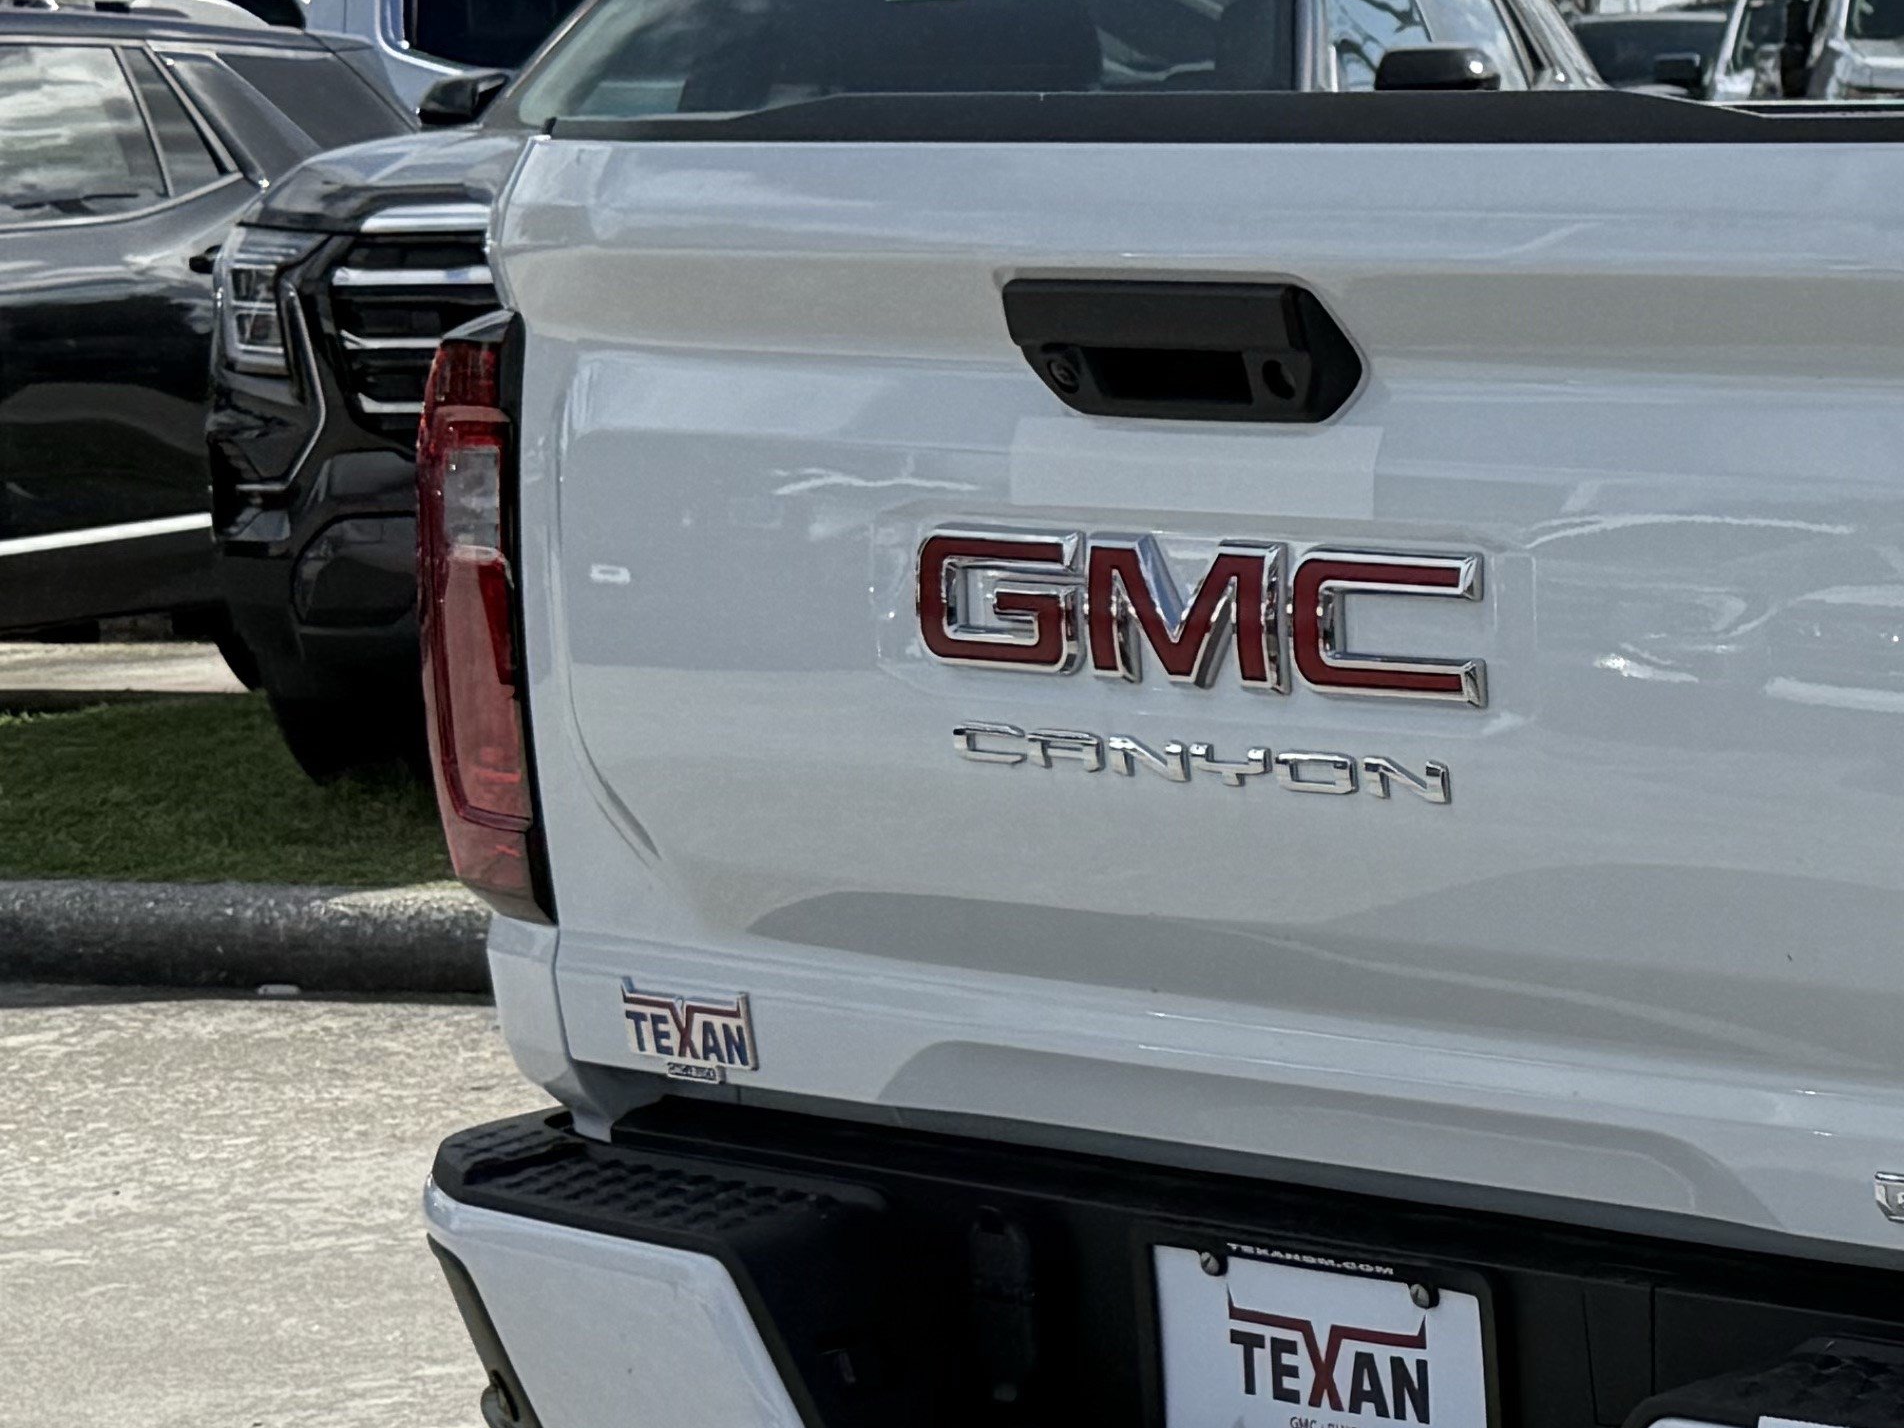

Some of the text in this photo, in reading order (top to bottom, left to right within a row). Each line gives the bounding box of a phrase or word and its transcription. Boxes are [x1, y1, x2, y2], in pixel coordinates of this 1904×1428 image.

[914, 523, 1490, 711] GMC
[951, 720, 1453, 806] CANYON
[621, 988, 751, 1067] TEXAN
[1228, 1294, 1432, 1426] TEXAN
